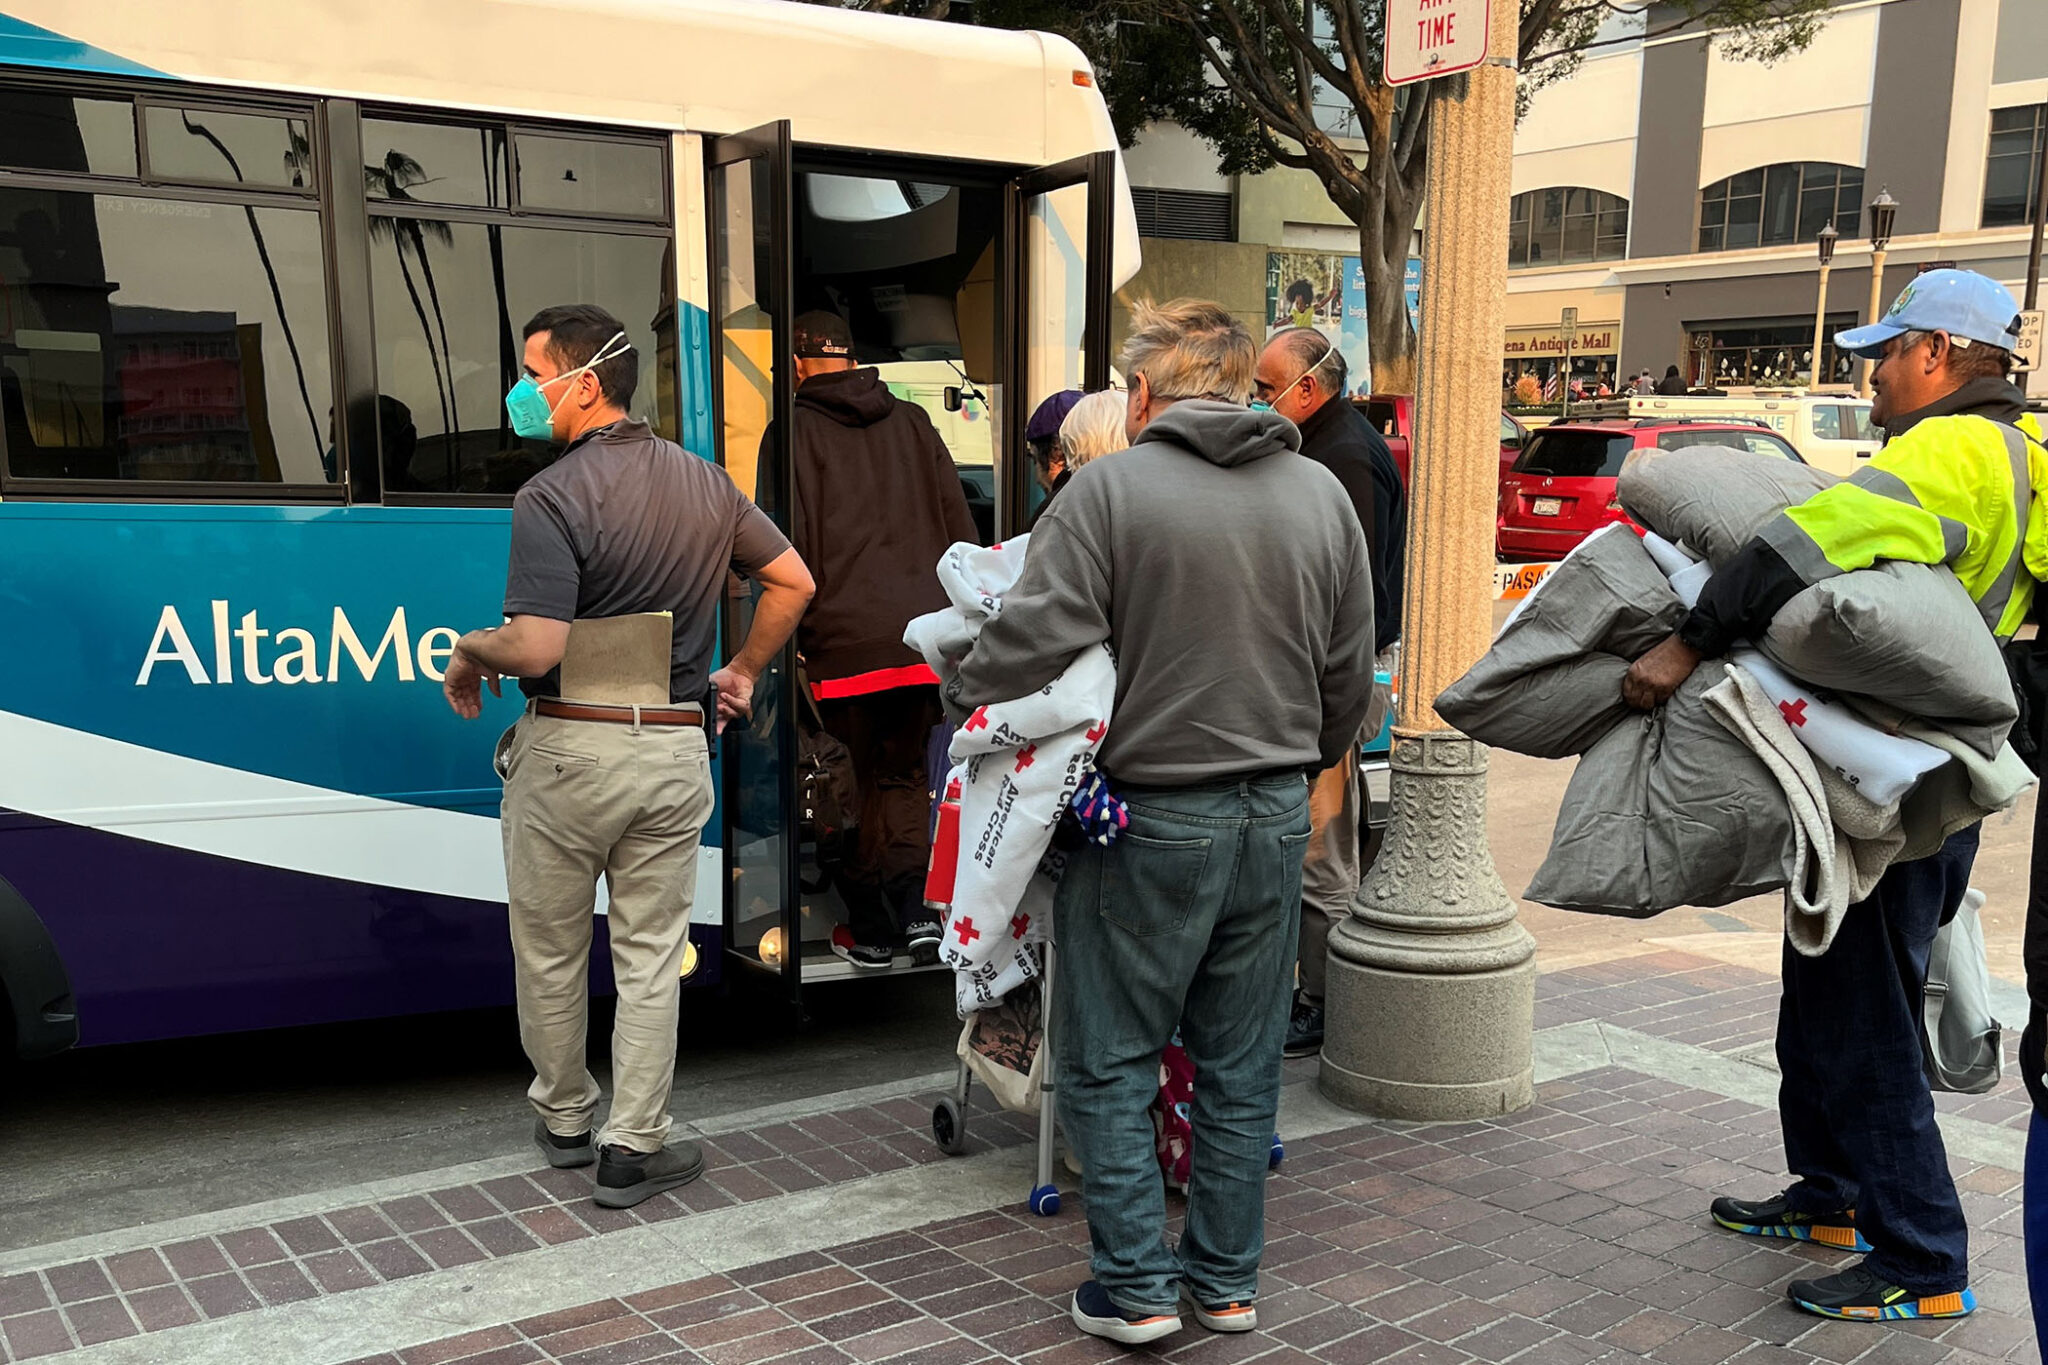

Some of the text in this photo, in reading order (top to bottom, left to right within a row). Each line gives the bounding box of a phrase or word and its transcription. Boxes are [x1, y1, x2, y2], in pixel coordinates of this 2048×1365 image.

[1418, 13, 1456, 51] TIME
[2022, 316, 2039, 327] OP
[1529, 336, 1579, 354] Antique
[1582, 332, 1611, 350] Mall
[2017, 339, 2033, 349] ED
[1502, 570, 1551, 591] PASA
[135, 600, 515, 687] AltaMe
[1064, 753, 1081, 787] Red
[974, 809, 1000, 862] Cross
[985, 780, 1019, 869] American
